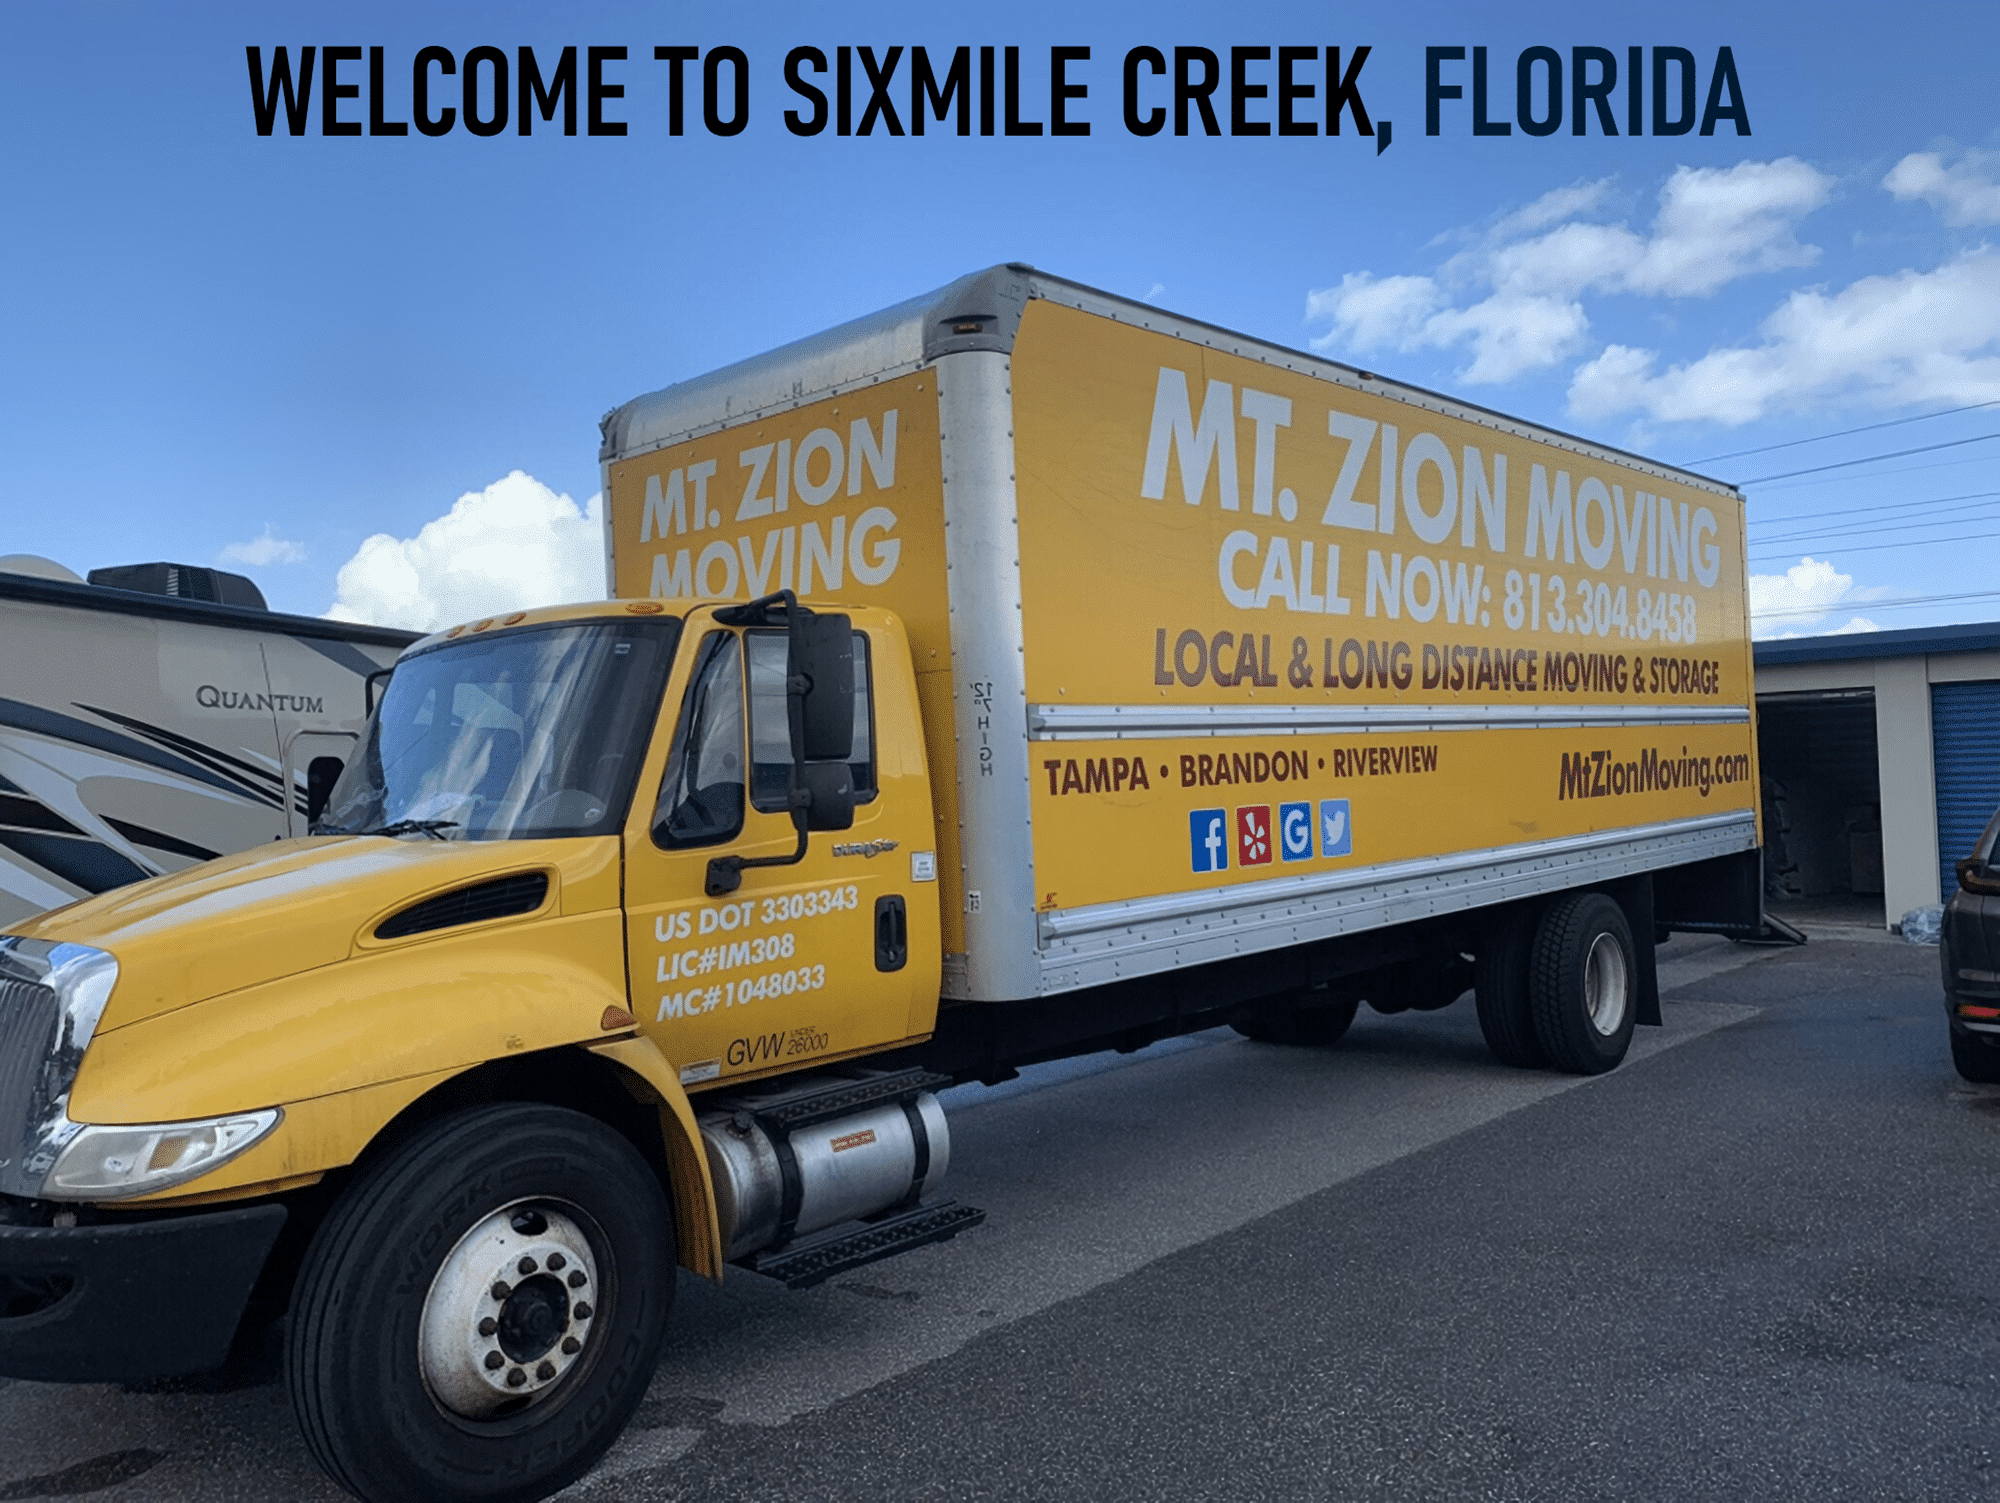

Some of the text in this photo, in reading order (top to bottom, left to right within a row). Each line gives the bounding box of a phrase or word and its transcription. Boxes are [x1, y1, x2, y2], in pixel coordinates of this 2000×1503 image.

[639, 409, 898, 543] MT. ZION
[1141, 366, 1720, 588] MT. ZION MOVING
[650, 506, 901, 600] MOVING
[1218, 529, 1697, 644] CALL NOW: 813.304.8458
[1154, 628, 1719, 694] LOCAL & LONG DISTANCE MOVING & STORAGE
[196, 685, 323, 713] QUANTUM
[1044, 745, 1438, 796] TAMPA BRANDON RIVERVIEW
[1559, 745, 1749, 801] MtZionMoving.com
[655, 885, 858, 942] US DOT 3303343
[656, 933, 795, 982] LIC#IM308
[656, 963, 826, 1022] MC#1048033
[727, 1031, 785, 1067] GVW
